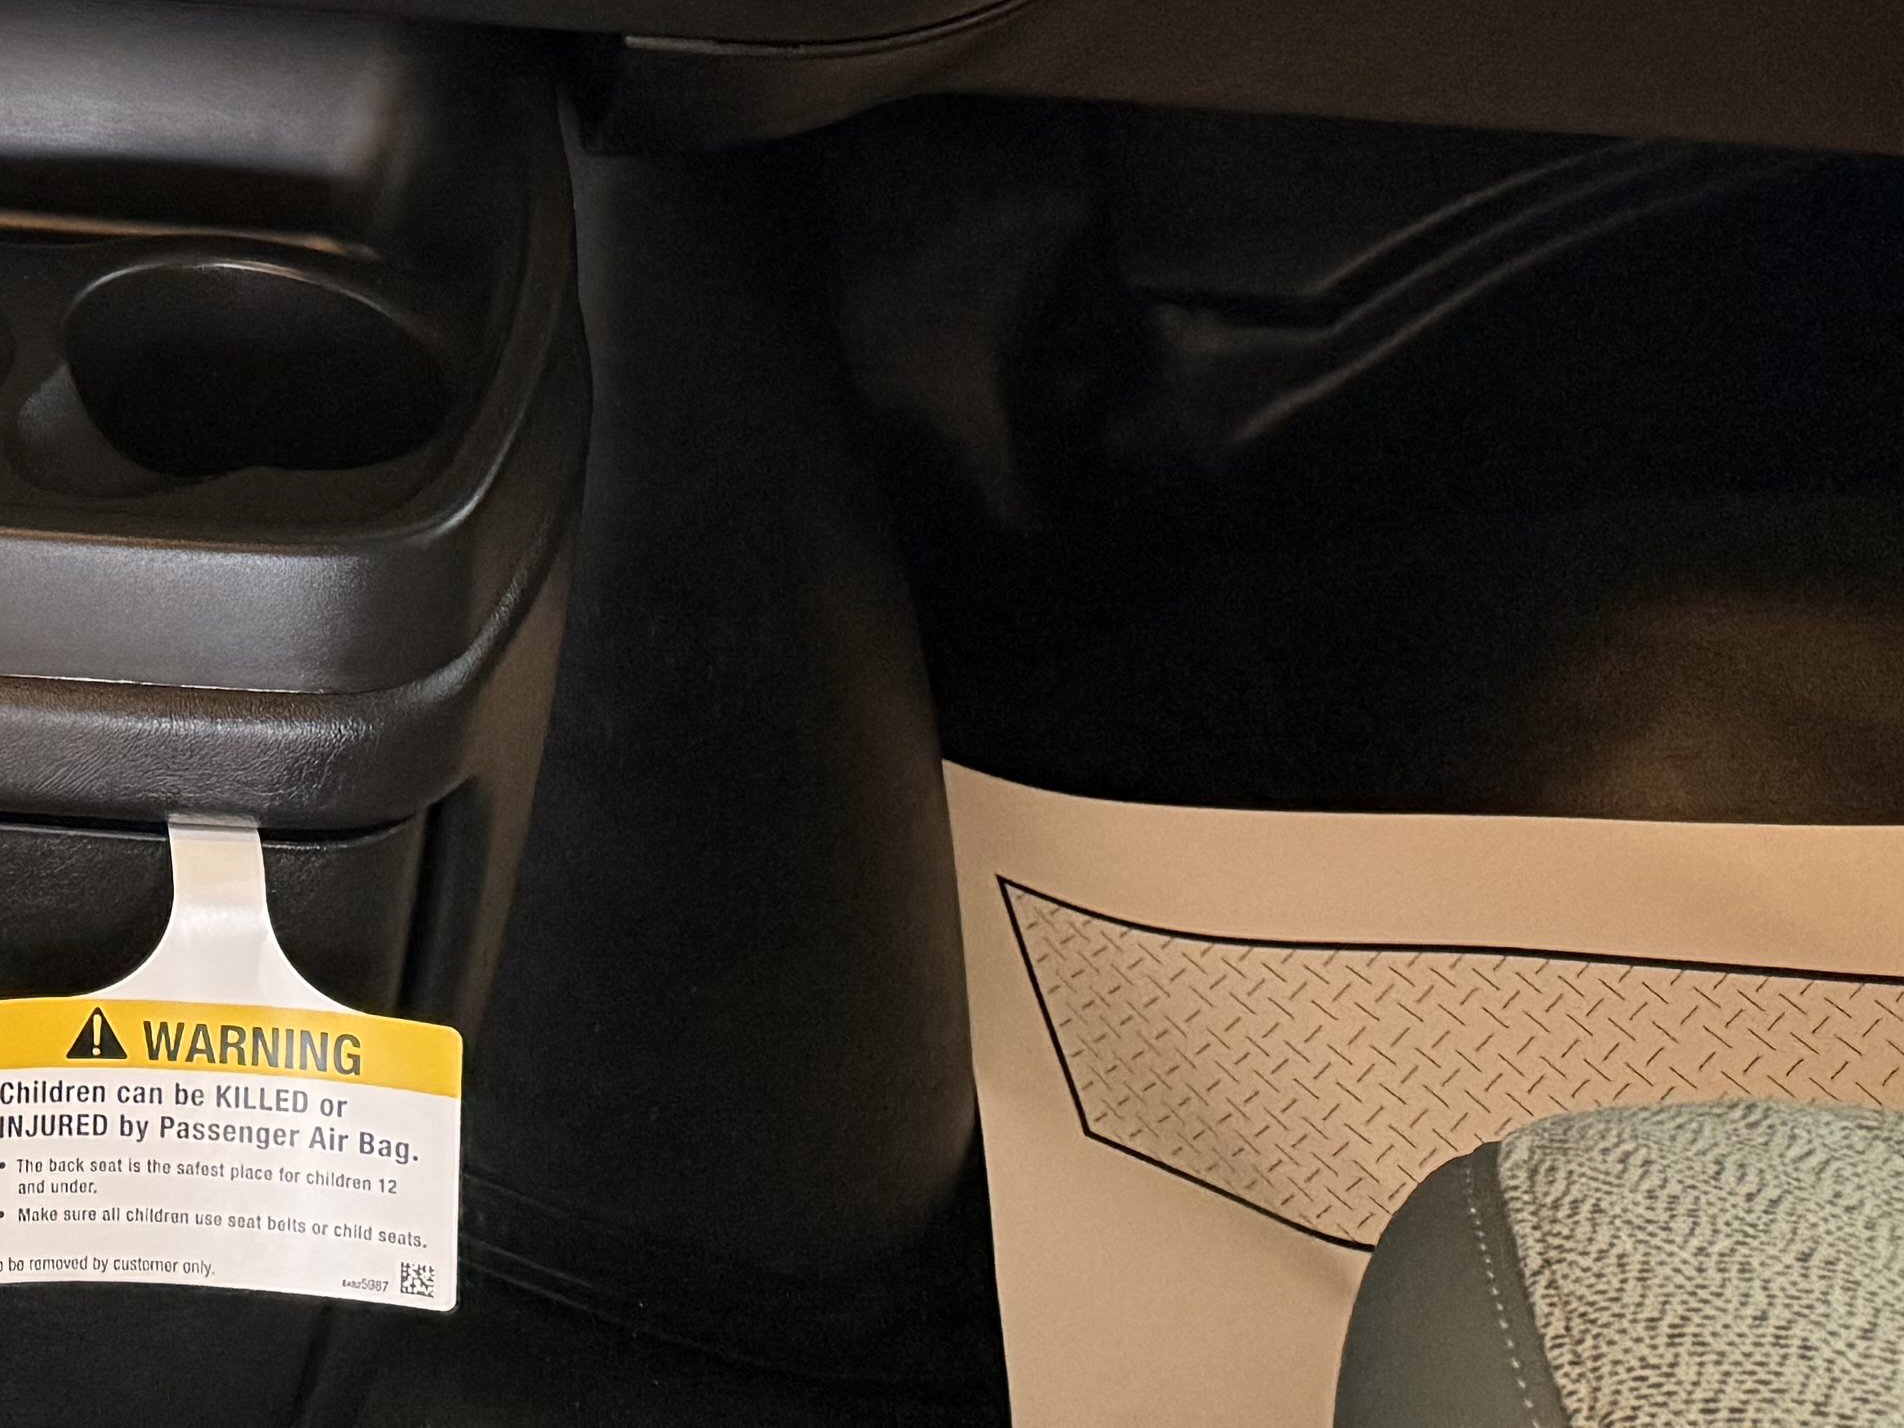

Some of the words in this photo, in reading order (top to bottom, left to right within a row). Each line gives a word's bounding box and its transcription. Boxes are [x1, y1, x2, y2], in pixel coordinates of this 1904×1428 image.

[143, 1020, 362, 1077] WARNING
[0, 1080, 106, 1105] Children
[117, 1084, 163, 1105] can
[175, 1082, 205, 1106] be
[215, 1084, 309, 1114] KILLED
[319, 1097, 348, 1118] or
[0, 1114, 108, 1139] INJURED
[119, 1114, 149, 1143] by
[160, 1115, 300, 1150] Passenger
[308, 1125, 349, 1153] Air
[359, 1131, 419, 1165] Bag.
[16, 1158, 43, 1173] The
[49, 1157, 85, 1173] back
[90, 1159, 123, 1173] seat
[128, 1157, 141, 1173] is
[147, 1159, 171, 1174] the
[177, 1161, 224, 1178] safest
[230, 1164, 273, 1181] place
[279, 1167, 301, 1184] for
[306, 1170, 372, 1191] children
[378, 1178, 397, 1194] 12
[18, 1180, 45, 1194] and
[51, 1180, 97, 1194] under.
[18, 1207, 58, 1222] Make
[63, 1210, 97, 1222] sure
[102, 1207, 120, 1222] all
[126, 1208, 189, 1225] children
[195, 1212, 222, 1226] use
[228, 1214, 261, 1230] seat
[267, 1216, 306, 1233] belts
[312, 1222, 328, 1235] or
[334, 1224, 372, 1241] child
[378, 1229, 427, 1249] seats.
[8, 1257, 24, 1272] be
[29, 1256, 88, 1271] removed
[92, 1257, 109, 1273] by
[113, 1258, 178, 1273] customer
[183, 1260, 215, 1277] only.
